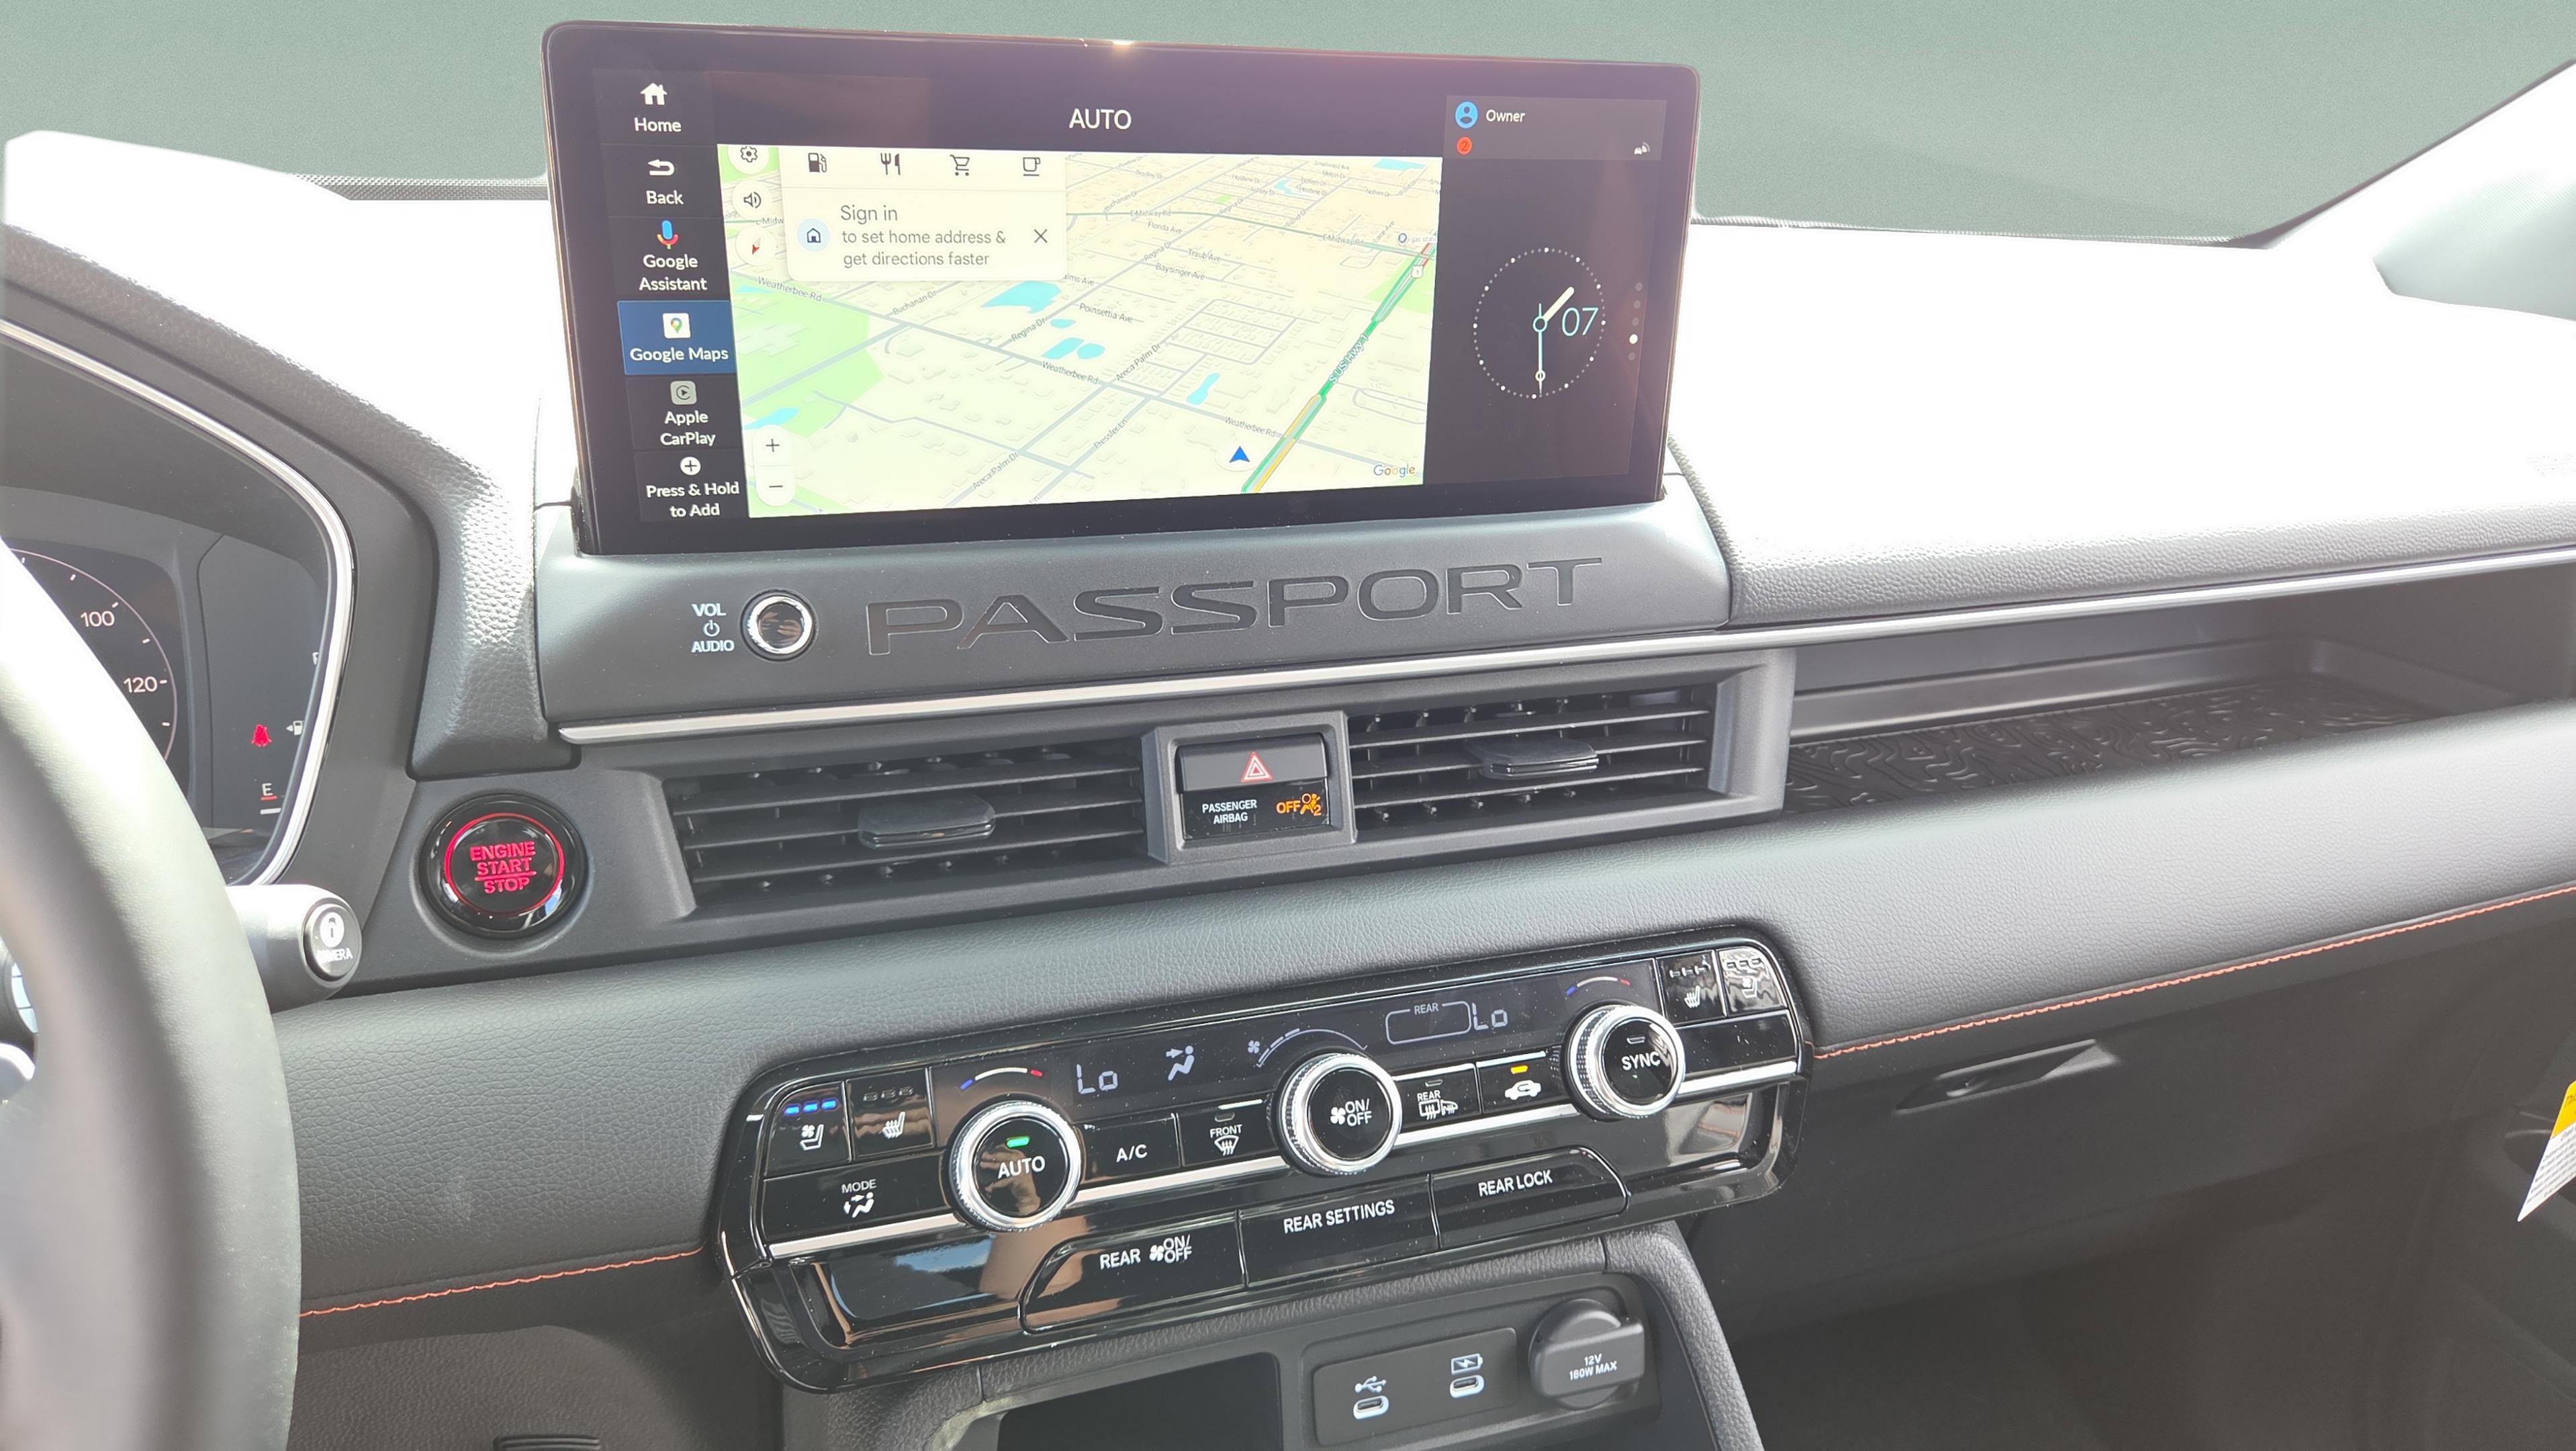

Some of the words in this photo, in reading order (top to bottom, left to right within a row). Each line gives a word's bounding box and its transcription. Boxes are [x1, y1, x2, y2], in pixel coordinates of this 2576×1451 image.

[1069, 109, 1132, 130] AUTO
[1485, 109, 1525, 123] Owner
[634, 117, 682, 133] Home
[646, 190, 684, 206] Back
[840, 204, 878, 225] Sign
[883, 204, 898, 221] in
[1170, 226, 1183, 234] Ave
[1385, 220, 1395, 232] Ave
[842, 231, 857, 244] to
[862, 231, 885, 244] set
[889, 230, 930, 244] home
[935, 230, 992, 244] address
[996, 230, 1006, 244] &
[1328, 234, 1354, 246] Midway
[1354, 238, 1364, 247] Rd
[843, 253, 867, 269] get
[872, 251, 944, 265] directions
[948, 251, 989, 265] faster
[1144, 246, 1165, 261] Regina
[1188, 249, 1207, 259] Traub
[1208, 254, 1221, 262] Ave
[643, 254, 698, 270] Google
[1156, 262, 1191, 277] Baysinger
[1192, 271, 1205, 281] Ave
[639, 277, 708, 292] Assistant
[757, 276, 808, 297] Weatherbee
[810, 292, 823, 302] Rd
[1082, 277, 1095, 286] Ave
[892, 295, 928, 316] Buchanan
[927, 290, 937, 299] Dr
[1079, 302, 1117, 320] Poinsettia
[1119, 313, 1134, 323] Ave
[1011, 322, 1037, 342] Regina
[1036, 317, 1046, 327] Dr
[1561, 307, 1599, 337] 07
[630, 347, 685, 363] Google
[688, 347, 729, 362] Maps
[1343, 341, 1365, 363] Hwy
[1115, 364, 1136, 382] Areca
[1134, 350, 1153, 366] Palm
[1152, 343, 1161, 353] Dr
[1333, 361, 1349, 377] US
[1042, 360, 1087, 381] Weatherbee
[1087, 374, 1099, 385] Rd
[1329, 374, 1338, 385] S
[665, 411, 708, 427] Apple
[1224, 416, 1266, 435] Weatherbee
[1266, 428, 1277, 437] Rd
[660, 432, 717, 448] CarPlay
[1093, 425, 1120, 449] Pressler
[1118, 418, 1128, 428] Ln
[972, 473, 993, 490] Areca
[991, 459, 1011, 475] Palm
[1009, 452, 1019, 461] Dr
[1373, 464, 1416, 478] Google
[646, 484, 685, 498] Press
[688, 483, 701, 496] &
[704, 482, 740, 496] Hold
[670, 504, 686, 517] to
[690, 503, 721, 517] Add
[692, 603, 727, 618] VOL
[866, 557, 1602, 656] PASSPORT
[81, 611, 115, 627] 100
[691, 638, 735, 654] AUDIO
[124, 676, 158, 693] 120
[262, 783, 273, 796] E
[1202, 799, 1258, 814] PASSENGER
[1276, 799, 1300, 814] OFF
[1213, 812, 1248, 825] AIRBAG
[469, 841, 536, 861] ENGINE
[477, 857, 532, 876] START
[484, 877, 530, 894] STOP
[317, 947, 354, 963] ERA
[1414, 1002, 1439, 1015] REAR
[1472, 1002, 1508, 1030] Lo
[1622, 1051, 1662, 1071] SYNC
[1076, 1063, 1118, 1094] Lo
[1417, 1090, 1441, 1102] REAR
[1344, 1098, 1370, 1113] ON/
[1346, 1110, 1372, 1127] OFF
[1209, 1124, 1243, 1139] FRONT
[1116, 1143, 1148, 1163] A/C
[997, 1155, 1046, 1180] AUTO
[841, 1178, 877, 1194] MODE
[1478, 1176, 1515, 1197] REAR
[1516, 1170, 1553, 1189] LOCK
[1283, 1212, 1323, 1234] REAR
[1326, 1199, 1395, 1227] SETTINGS
[1099, 1248, 1141, 1270] REAR
[1163, 1233, 1191, 1251] ON/
[1164, 1245, 1192, 1264] OFF
[1584, 1353, 1602, 1367] 12V
[1596, 1360, 1618, 1375] MAX
